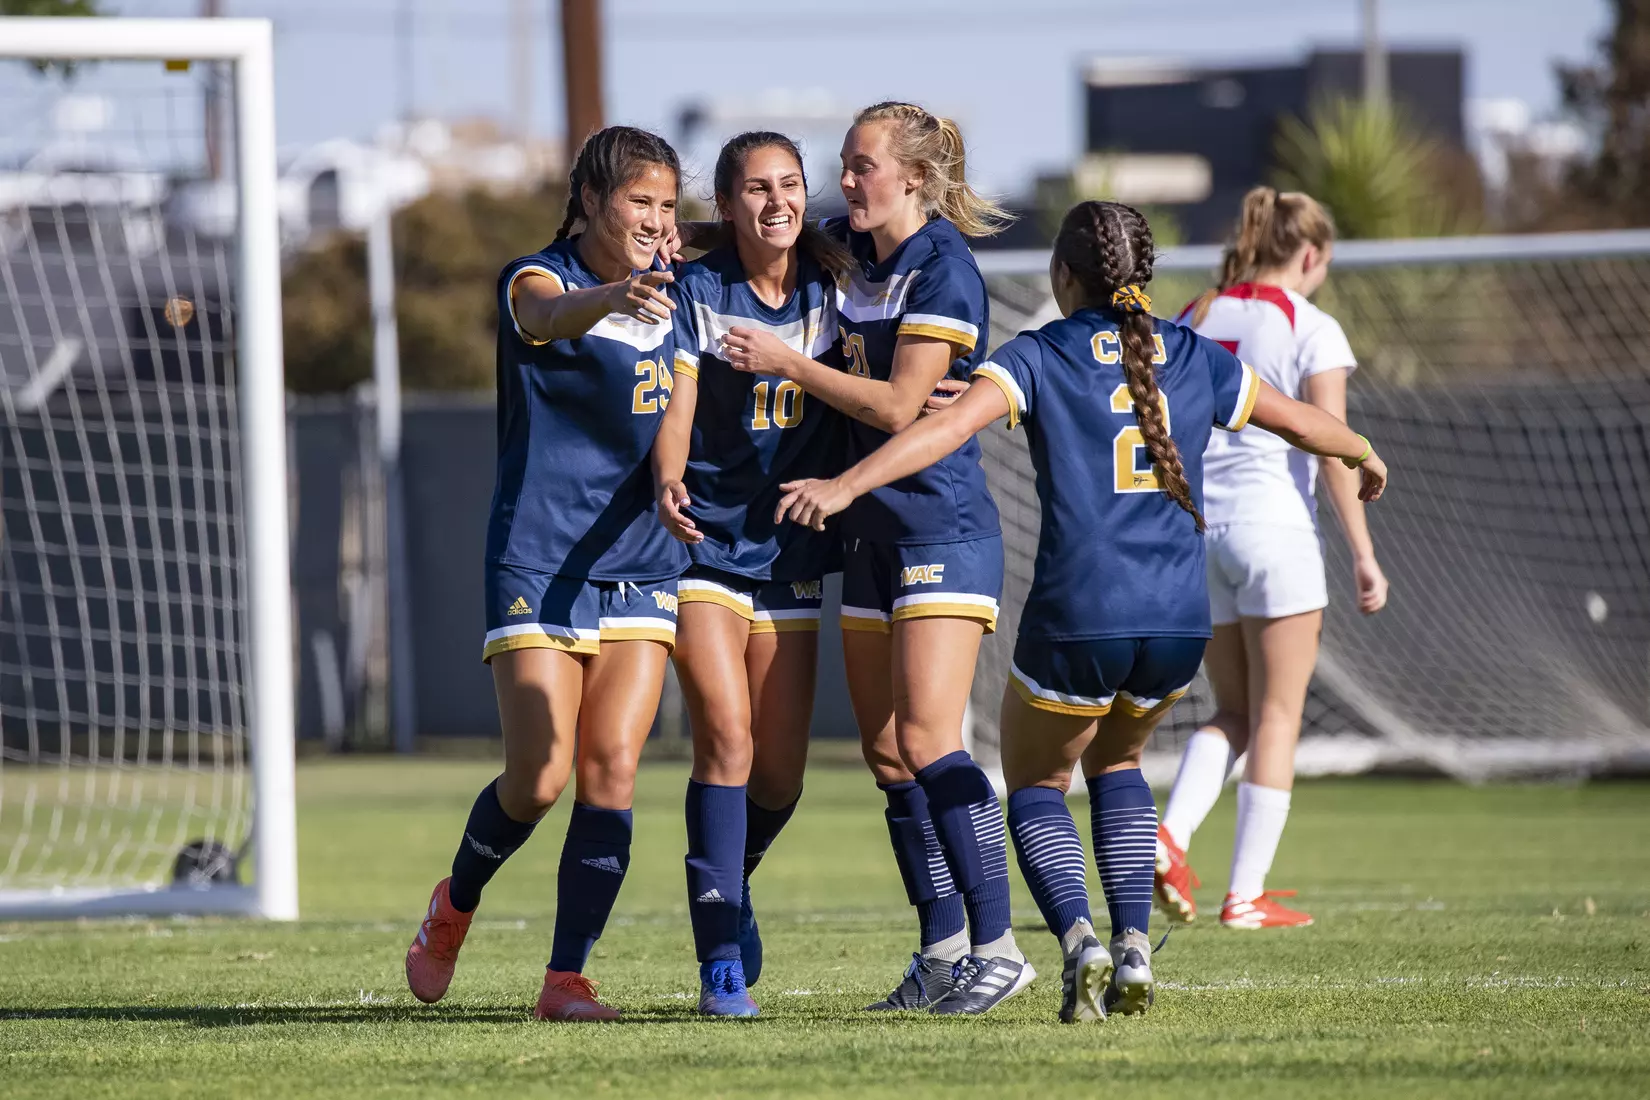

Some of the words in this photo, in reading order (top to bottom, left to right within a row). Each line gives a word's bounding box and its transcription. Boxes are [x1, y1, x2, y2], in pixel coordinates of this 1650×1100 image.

[1090, 330, 1168, 364] CU
[632, 356, 674, 414] 29
[752, 380, 804, 430] 10
[1110, 383, 1171, 493] 2
[790, 581, 823, 599] WA
[901, 564, 945, 587] WAC
[507, 607, 533, 616] adidas
[651, 590, 678, 616] WA
